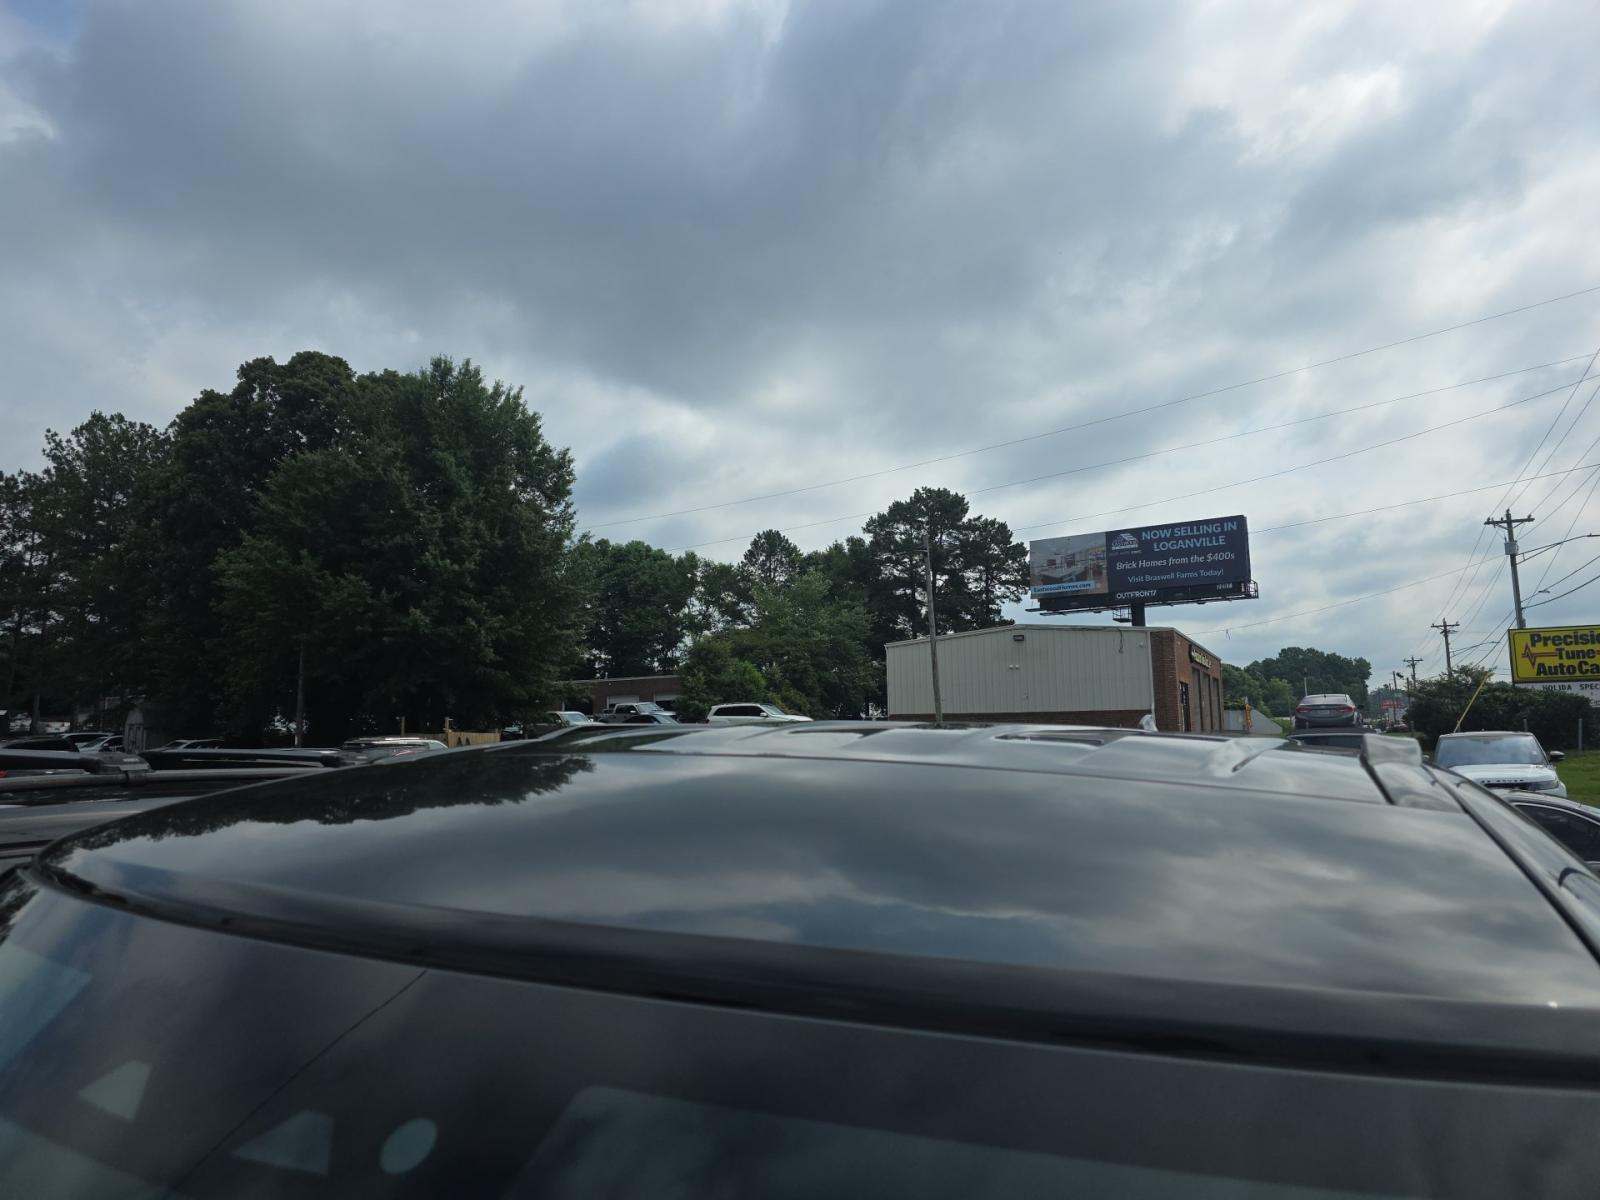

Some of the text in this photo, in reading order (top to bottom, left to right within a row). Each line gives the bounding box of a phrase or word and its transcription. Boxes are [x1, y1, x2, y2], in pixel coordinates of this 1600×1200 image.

[1142, 521, 1237, 540] NOW SELLING IN
[1153, 535, 1226, 552] LOGANVILLE
[1116, 551, 1235, 571] Brick Homes from the $400s
[1128, 568, 1224, 583] Visit Braswell Farms Today!
[1556, 647, 1596, 660] Tune
